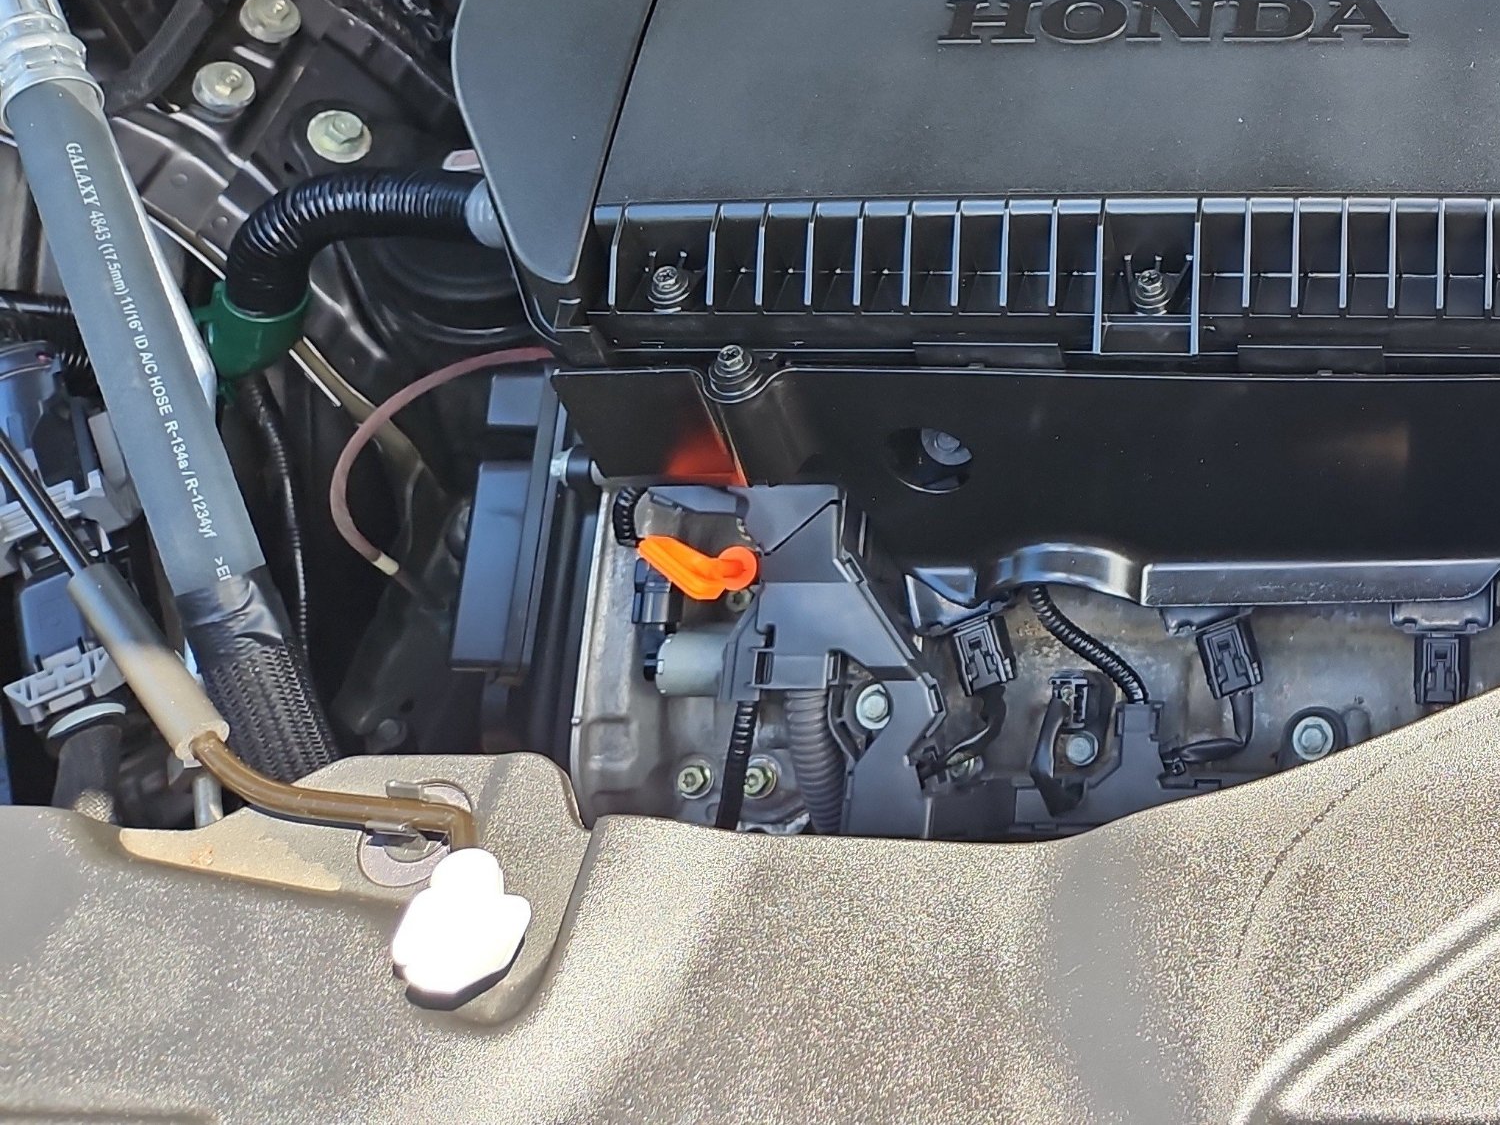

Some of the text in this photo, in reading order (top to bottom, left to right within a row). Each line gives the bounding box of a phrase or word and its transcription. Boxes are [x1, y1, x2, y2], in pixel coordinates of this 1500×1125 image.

[66, 142, 101, 207] GALAXY
[89, 210, 111, 242] 4843
[98, 243, 130, 296] (17.5mm)
[134, 334, 149, 350] ID
[139, 352, 158, 375] A/C
[149, 376, 173, 416] HOSE
[164, 420, 189, 470] R-134a
[184, 478, 218, 539] R-1234yf
